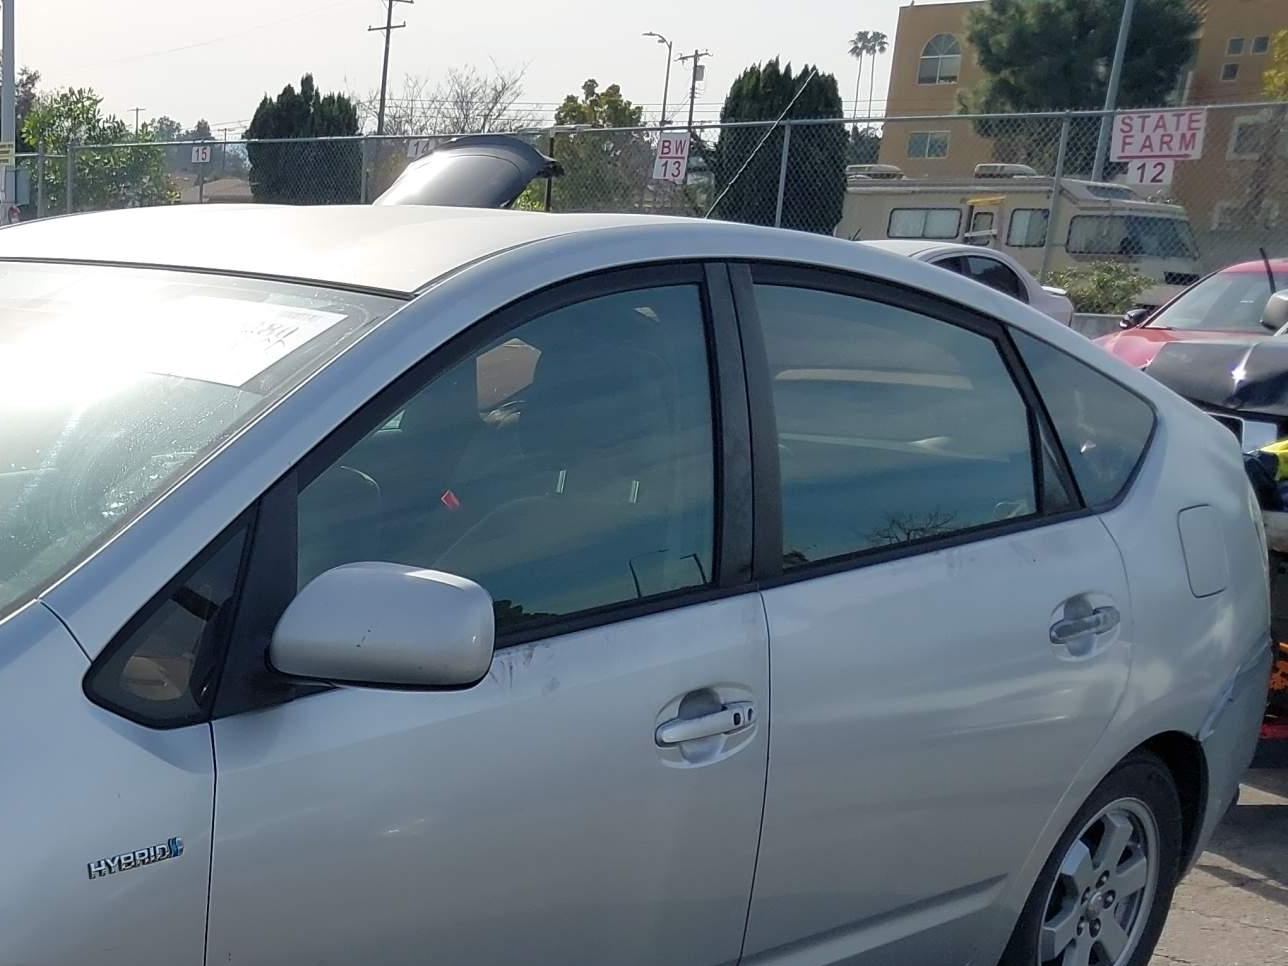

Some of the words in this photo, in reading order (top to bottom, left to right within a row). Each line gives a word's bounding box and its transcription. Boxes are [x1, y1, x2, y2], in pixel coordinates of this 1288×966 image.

[1120, 112, 1202, 134] STATE
[661, 139, 687, 155] BW
[1120, 132, 1197, 153] FARM
[195, 147, 208, 161] 15
[661, 160, 682, 178] 13
[1136, 162, 1166, 184] 12
[87, 843, 170, 880] HYBRID
